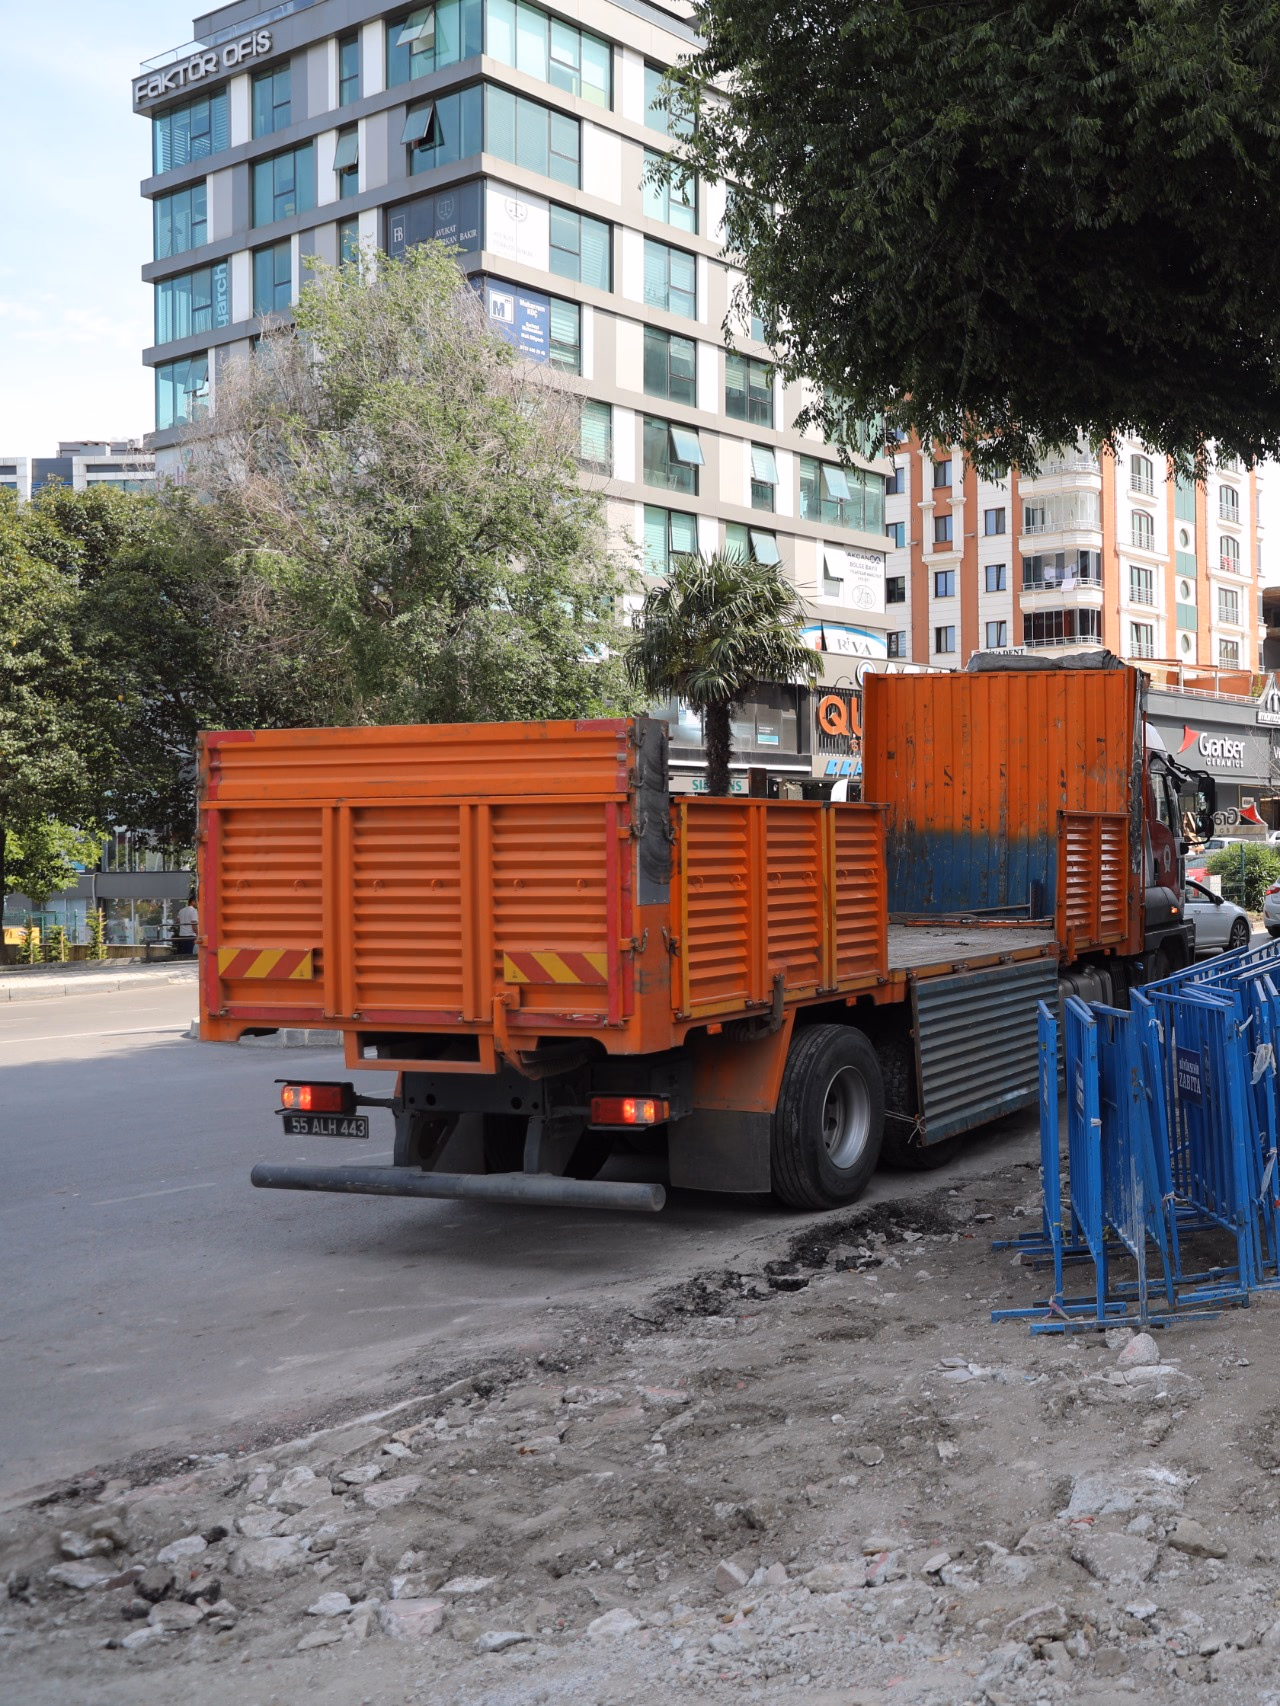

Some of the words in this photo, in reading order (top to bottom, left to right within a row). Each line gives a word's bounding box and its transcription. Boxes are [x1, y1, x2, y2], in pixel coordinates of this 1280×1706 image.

[435, 224, 457, 238] AVUKAT
[459, 228, 478, 242] BAKIR
[1200, 732, 1246, 759] Graniser
[1206, 757, 1244, 768] CERAMICS
[1178, 1073, 1202, 1094] ZABITA
[292, 1117, 308, 1133] 55
[312, 1118, 337, 1135] ALH
[340, 1120, 365, 1136] 443
